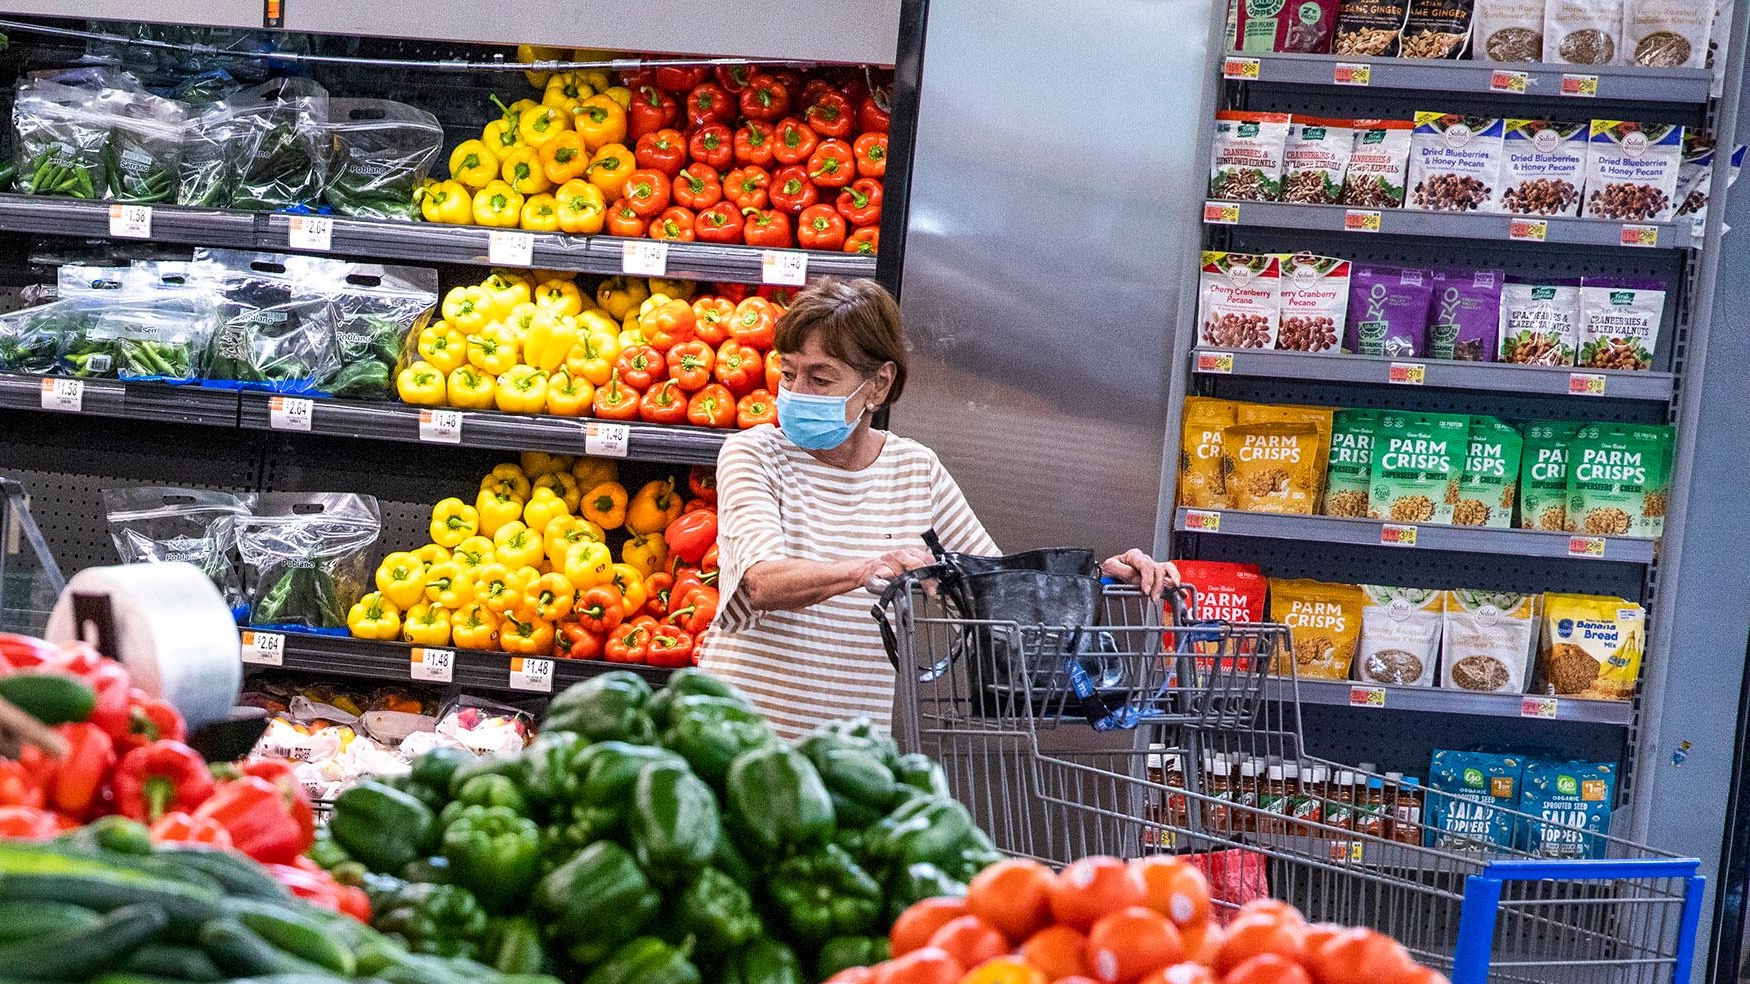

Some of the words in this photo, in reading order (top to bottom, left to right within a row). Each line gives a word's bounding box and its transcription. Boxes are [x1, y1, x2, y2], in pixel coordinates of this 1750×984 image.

[1371, 5, 1402, 16] GINGER
[1432, 8, 1467, 19] GINGER
[1223, 149, 1262, 158] CRANBERRIES
[1423, 148, 1442, 156] Dried
[1445, 149, 1489, 159] Blueberries
[1511, 154, 1533, 162] Dried
[1535, 155, 1579, 163] Blueberries
[120, 161, 150, 172] Serrano
[1432, 157, 1456, 167] Honey
[1458, 159, 1485, 168] Pecans
[1599, 157, 1621, 165] Dried
[1623, 158, 1667, 167] Blueberries
[351, 166, 387, 175] Poblano
[1521, 164, 1546, 172] Honey
[1609, 166, 1633, 176] Honey
[1636, 168, 1663, 176] Pecans
[1210, 285, 1234, 295] Cherry
[1235, 288, 1271, 298] Cranberry
[1298, 291, 1336, 299] Cranberry
[1227, 296, 1253, 304] Pecano
[1289, 298, 1316, 306] Pecano
[337, 333, 371, 343] Poblano
[1202, 431, 1222, 444] PA
[1245, 434, 1297, 447] PARM
[1332, 433, 1374, 448] PAR
[1390, 439, 1446, 455] PARM
[1239, 447, 1301, 464] CRISPS
[1328, 447, 1373, 464] CRIS
[1583, 450, 1641, 466] PARM
[1382, 453, 1450, 472] CRISPS
[1466, 457, 1505, 476] ISPS
[1382, 472, 1418, 480] SUPERSEEDS
[1426, 472, 1447, 481] CHEESE
[1531, 464, 1566, 480] CRI
[1576, 464, 1646, 484] CRISPS
[1576, 482, 1612, 490] SUPERSEEDS
[1620, 484, 1642, 493] CHEESE
[282, 559, 315, 569] Poblano
[1196, 592, 1247, 607] PARM
[1292, 601, 1341, 616] PARM
[1285, 613, 1345, 632] CRISPS
[1577, 621, 1616, 630] Banana
[1584, 630, 1618, 641] Bread
[258, 633, 278, 650] $2.64
[427, 653, 448, 667] $1.48
[527, 659, 548, 675] $1.48
[1543, 801, 1572, 810] SPROUTED
[1541, 810, 1586, 828] SALAD
